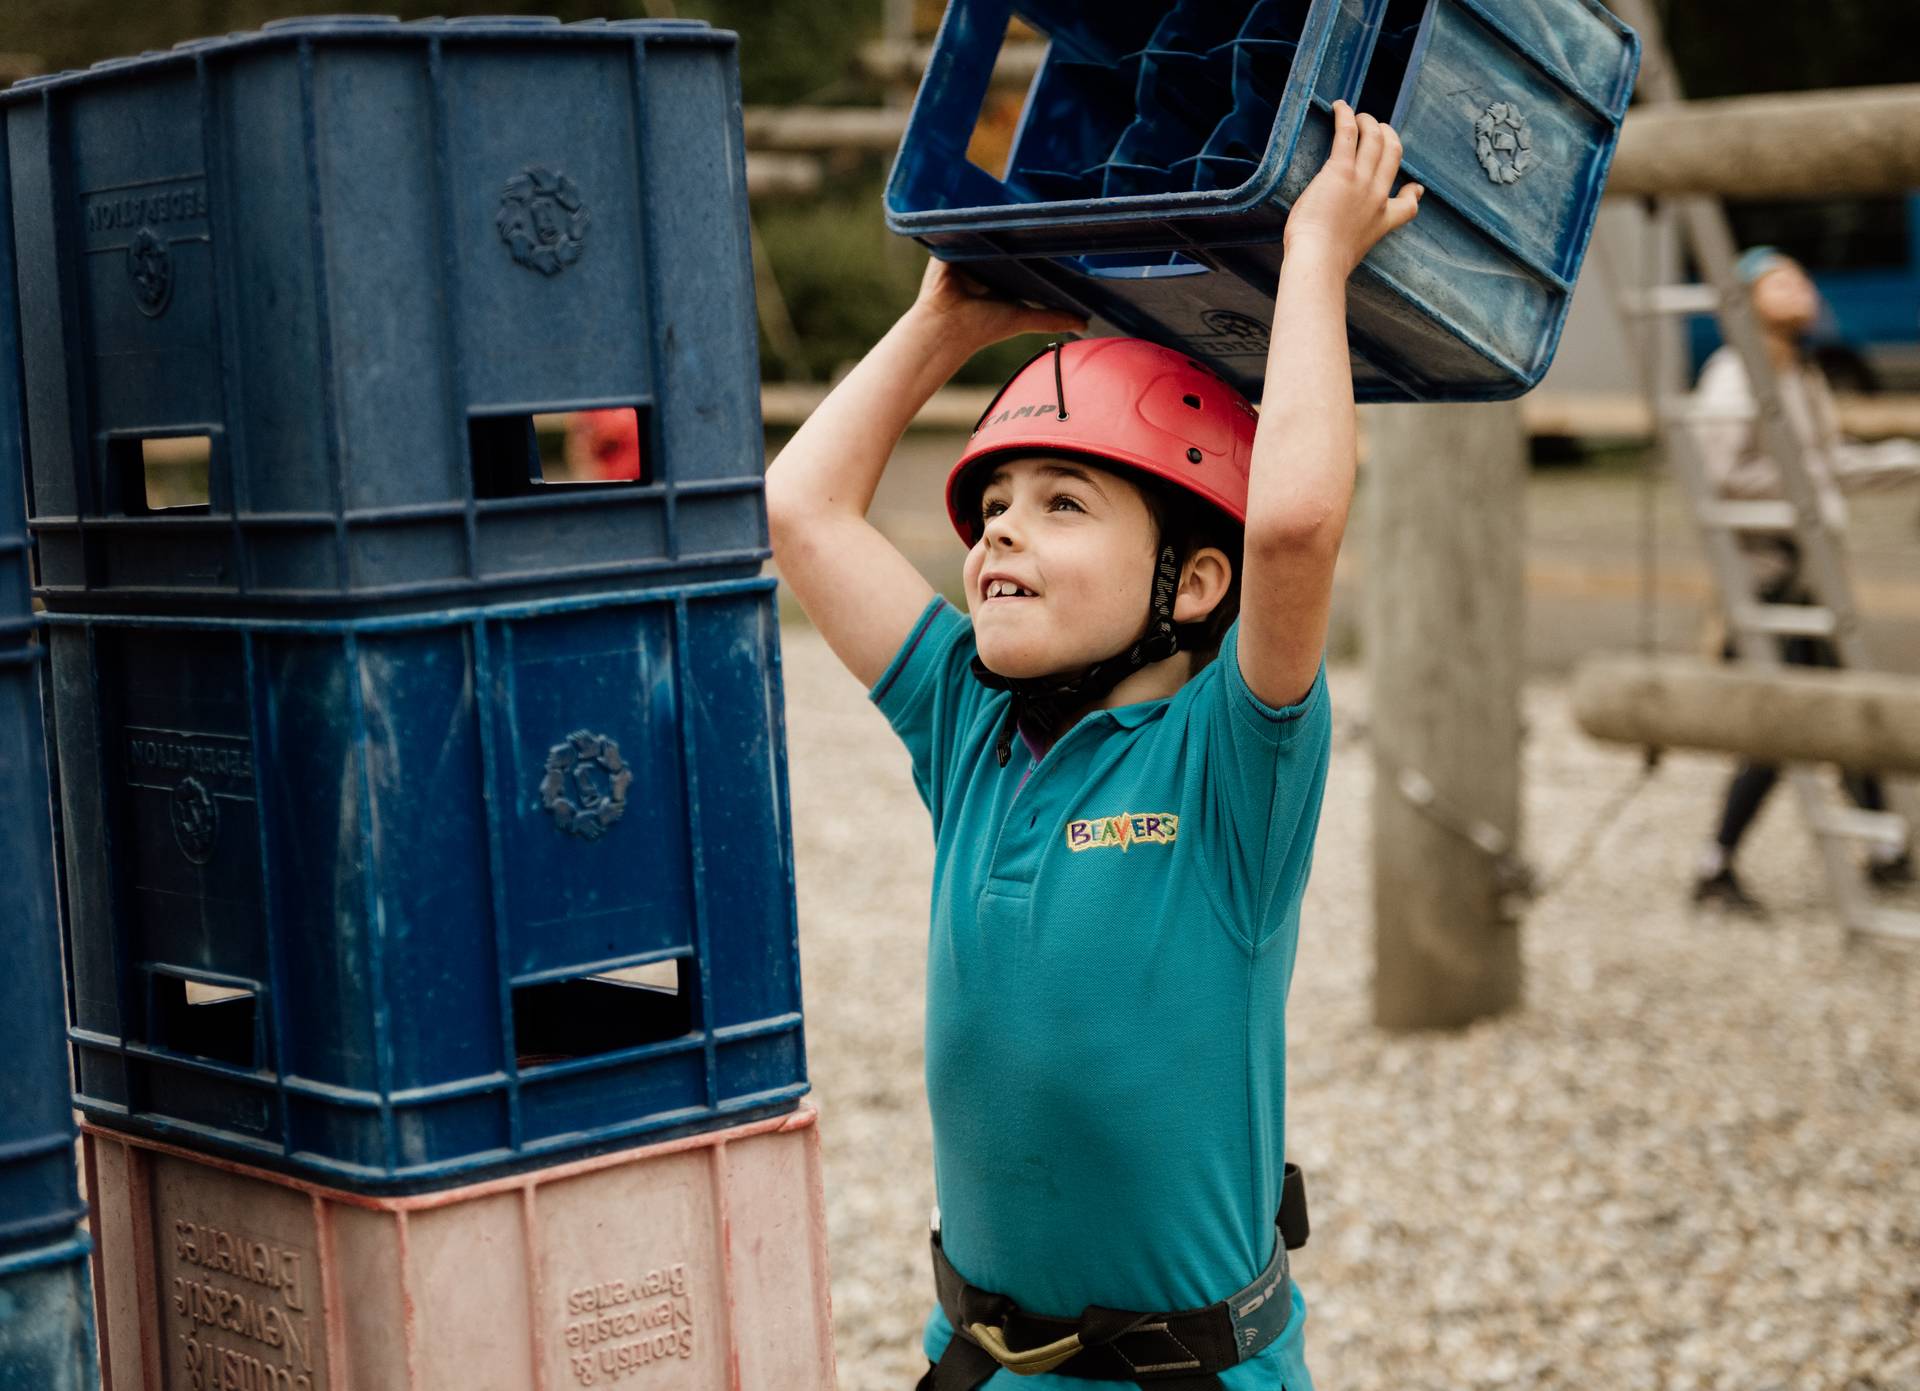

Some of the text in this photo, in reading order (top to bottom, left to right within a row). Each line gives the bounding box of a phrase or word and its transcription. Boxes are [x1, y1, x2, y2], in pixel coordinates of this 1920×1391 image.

[87, 190, 208, 232] FEDERATION
[130, 740, 253, 775] FEDERATION
[1069, 813, 1178, 850] BEAVERS
[175, 1218, 304, 1311] Breweries
[566, 1262, 688, 1319] Breweries
[173, 1275, 312, 1371] Newcastle
[564, 1296, 694, 1355] Newcastle
[569, 1328, 693, 1388] Scottish &
